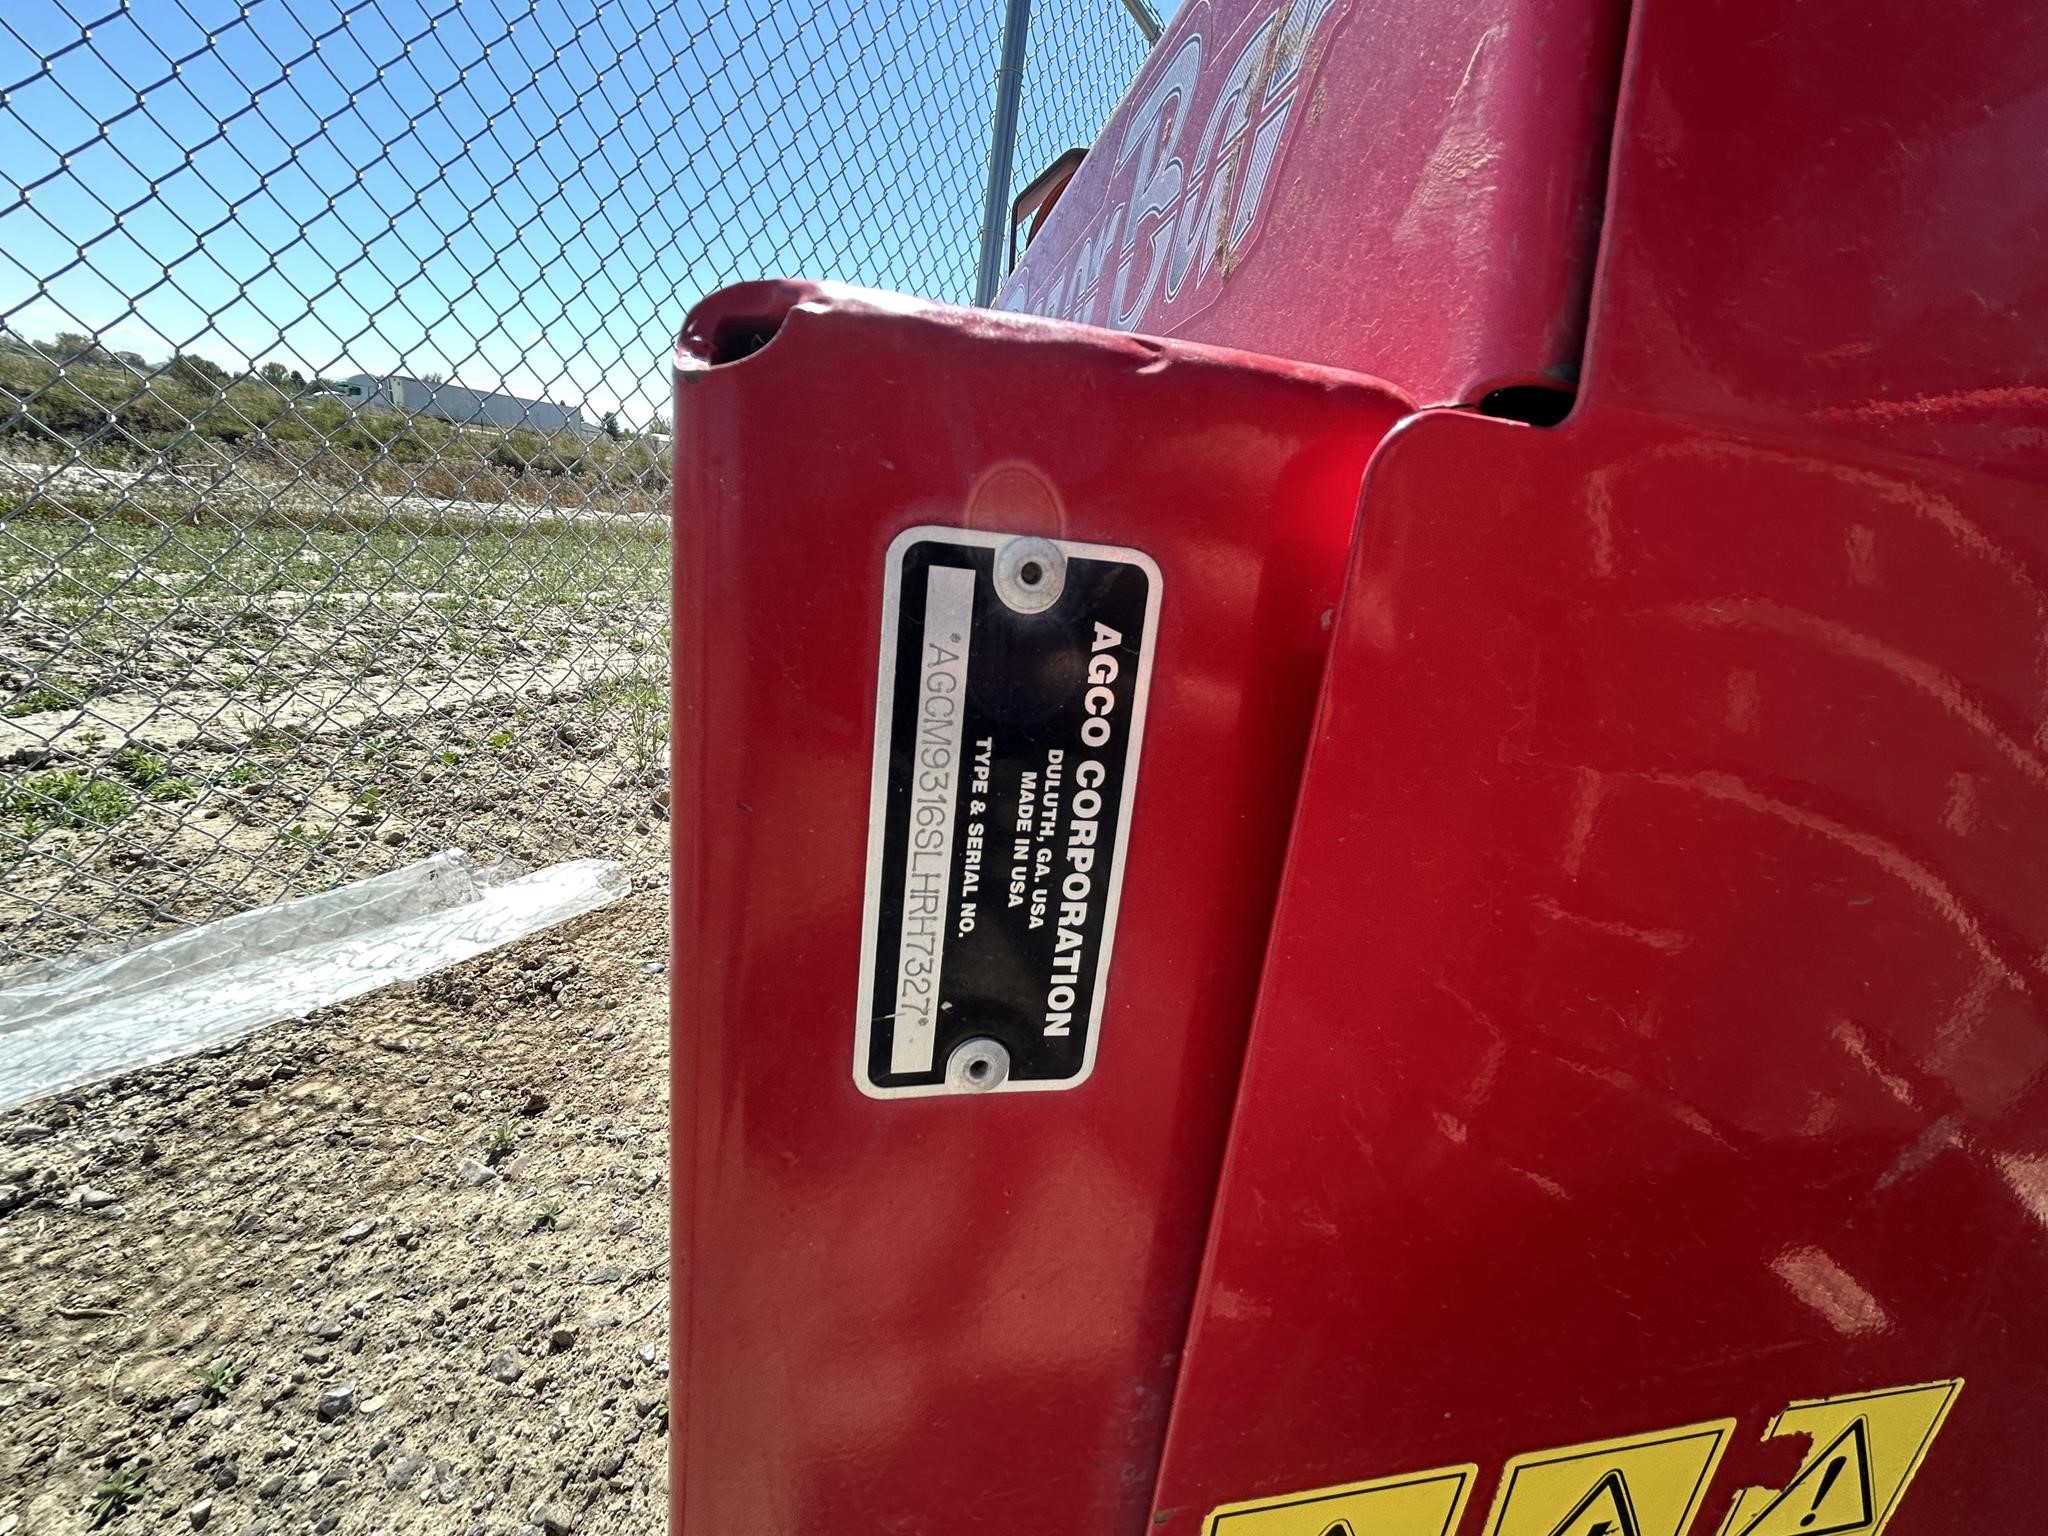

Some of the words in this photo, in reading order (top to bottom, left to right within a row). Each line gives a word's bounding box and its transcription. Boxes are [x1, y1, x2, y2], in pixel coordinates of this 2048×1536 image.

[1080, 620, 1122, 747] AGCO
[971, 735, 993, 795] TYPE
[969, 799, 987, 816] &
[1015, 770, 1037, 832] MADE
[1035, 748, 1064, 842] DULUTH,
[961, 822, 985, 897] SERIAL
[1012, 838, 1031, 860] IN
[1034, 848, 1053, 883] GA.
[1007, 866, 1028, 908] USA
[1028, 888, 1048, 930] USA
[1043, 759, 1106, 1036] CORPORATION
[957, 902, 977, 938] NO.
